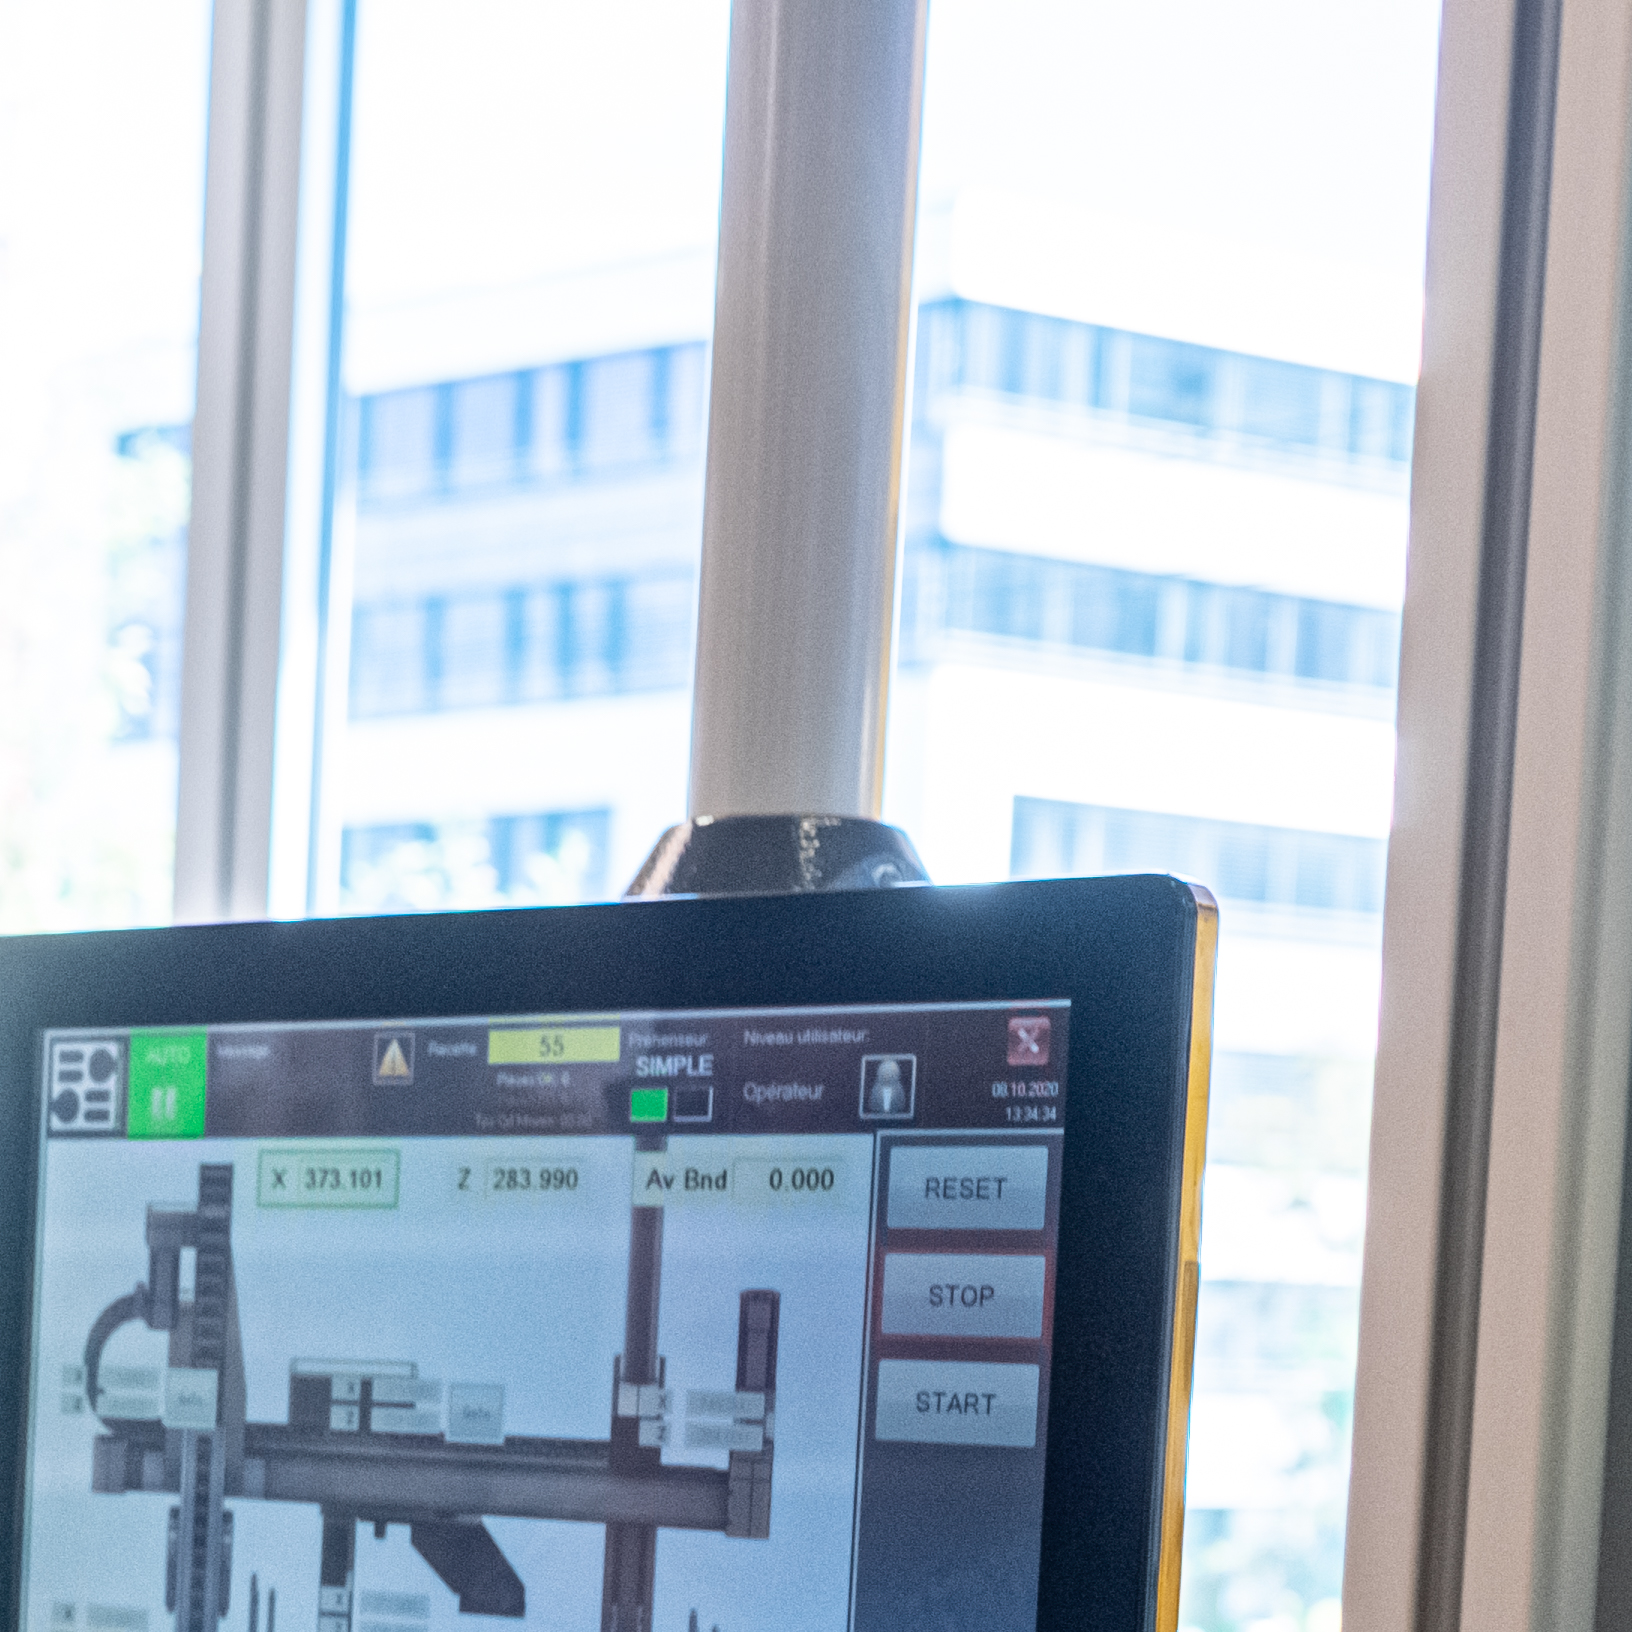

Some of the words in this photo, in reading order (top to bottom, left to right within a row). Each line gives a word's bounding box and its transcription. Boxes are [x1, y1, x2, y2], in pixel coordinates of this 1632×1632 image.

[539, 1034, 565, 1057] 55
[744, 1029, 793, 1047] Niveau
[144, 1045, 191, 1066] AUTO
[636, 1054, 714, 1077] SIMPLE
[743, 1080, 825, 1104] Opérateur
[271, 1169, 287, 1189] X
[305, 1168, 383, 1190] 373.101
[458, 1167, 471, 1190] Z
[493, 1168, 579, 1191] 283.990
[646, 1168, 675, 1190] Av
[685, 1168, 727, 1191] Bnd
[769, 1168, 835, 1191] 0.000
[924, 1177, 1007, 1200] RESET
[928, 1284, 995, 1308] STOP
[916, 1391, 997, 1415] START
